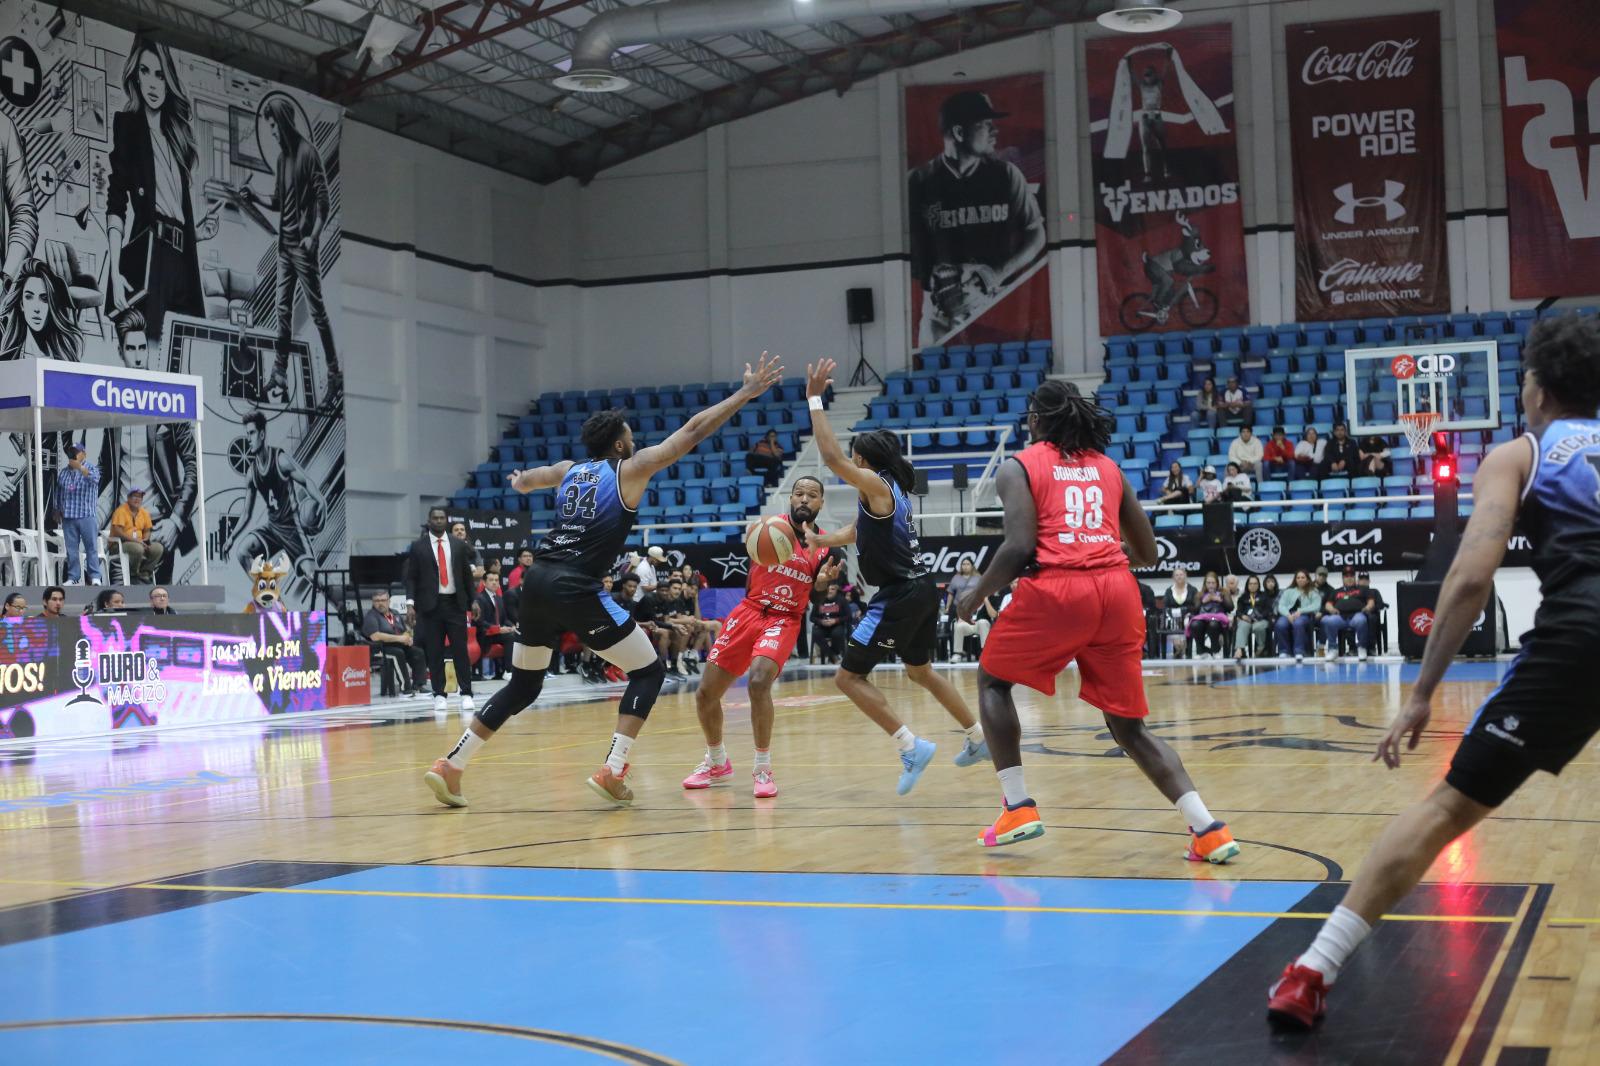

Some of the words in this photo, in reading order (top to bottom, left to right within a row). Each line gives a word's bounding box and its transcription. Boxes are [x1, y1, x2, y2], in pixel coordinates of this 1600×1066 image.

[1302, 38, 1420, 85] Coca-Cola
[1312, 108, 1416, 138] POWER
[1360, 131, 1417, 157] ADE
[1100, 180, 1238, 222] VENADOS
[1321, 229, 1363, 240] UNDER
[1366, 226, 1420, 237] ARMOUR
[1318, 258, 1424, 292] Caliente
[1345, 288, 1421, 302] caliente.mx
[91, 379, 186, 414] Chevron
[1053, 465, 1100, 481] JOHNSON
[563, 484, 598, 519] 34
[1064, 485, 1103, 530] 93
[1321, 528, 1382, 545] KIA
[920, 545, 989, 573] elcl
[1158, 560, 1201, 572] Azteca
[1322, 549, 1383, 566] Pacific
[768, 564, 813, 583] VENADO
[258, 646, 265, 661] 4
[266, 646, 274, 658] a
[275, 643, 282, 659] 5
[283, 640, 301, 657] PM
[0, 662, 45, 694] OS!
[98, 651, 146, 685] DURO
[148, 657, 160, 683] &
[253, 673, 264, 692] a
[267, 665, 321, 691] Viernes
[108, 683, 166, 706] MACIZO
